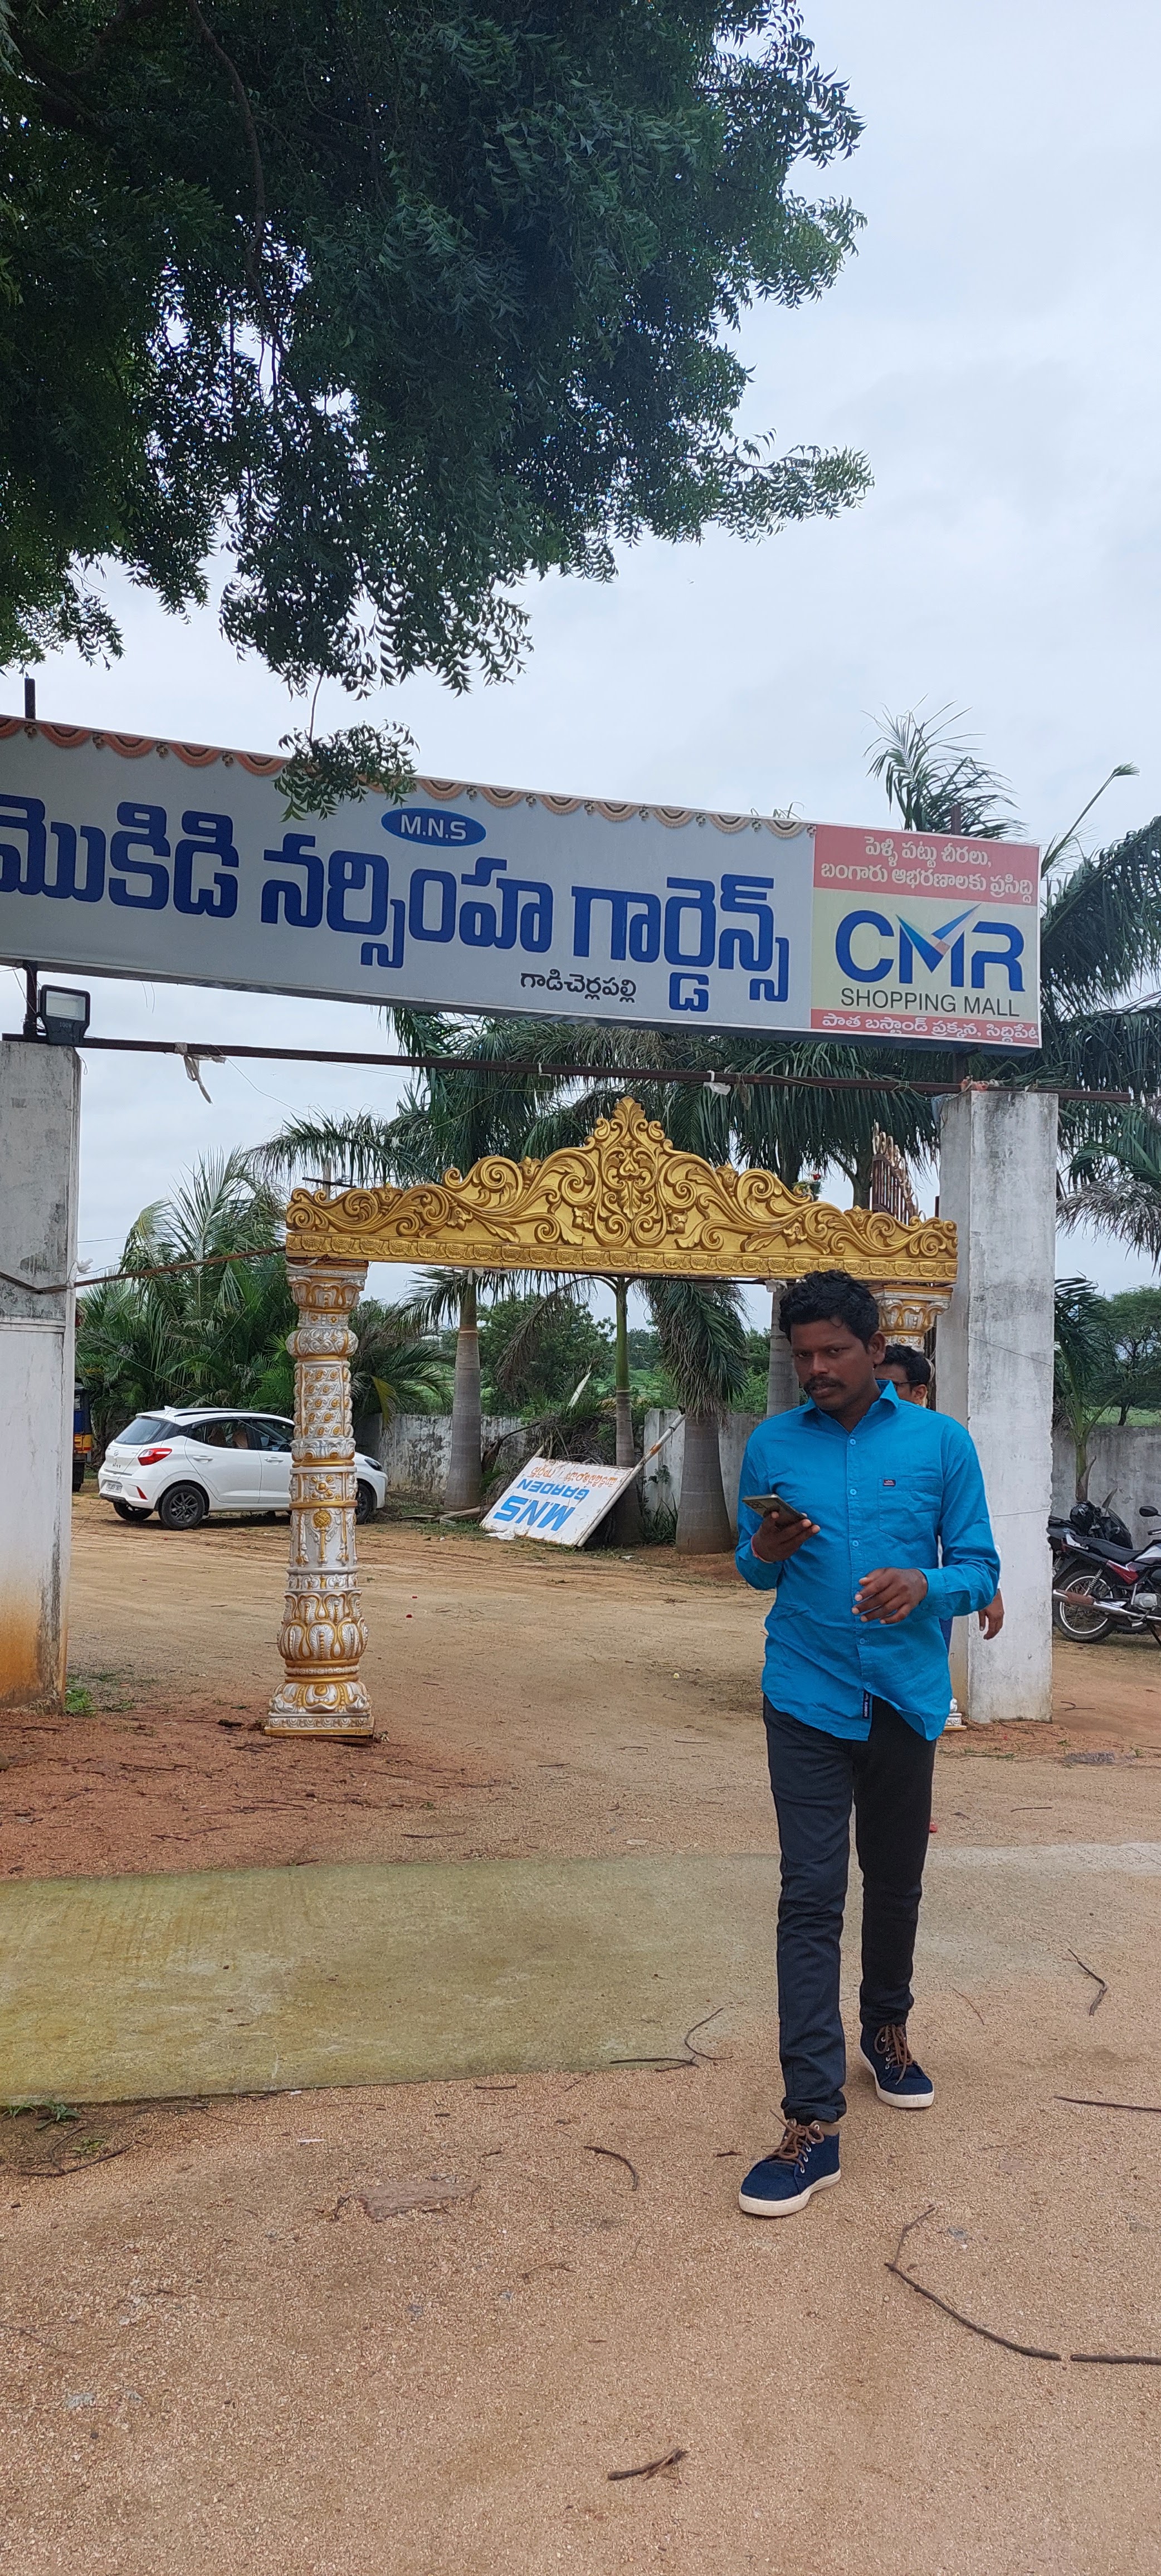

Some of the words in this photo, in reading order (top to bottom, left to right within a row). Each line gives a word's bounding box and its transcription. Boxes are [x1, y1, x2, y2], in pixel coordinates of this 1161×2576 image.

[400, 809, 467, 840] M.N.S
[902, 841, 936, 868] పట్టు
[942, 842, 992, 867] చీరలు,
[821, 863, 888, 882] బంగారు
[892, 869, 986, 889] ఆభరణాలకు
[571, 873, 789, 1012] గార్డెన్స్
[836, 903, 1026, 992] CMR
[520, 969, 637, 1003] గాడిచెర్లపల్లి
[841, 988, 956, 1012] SHOPPING
[964, 996, 1020, 1017] MALL
[822, 1013, 861, 1027] పాత
[931, 1021, 981, 1038] ప్రక్కన,
[517, 1479, 589, 1500] GARDEN
